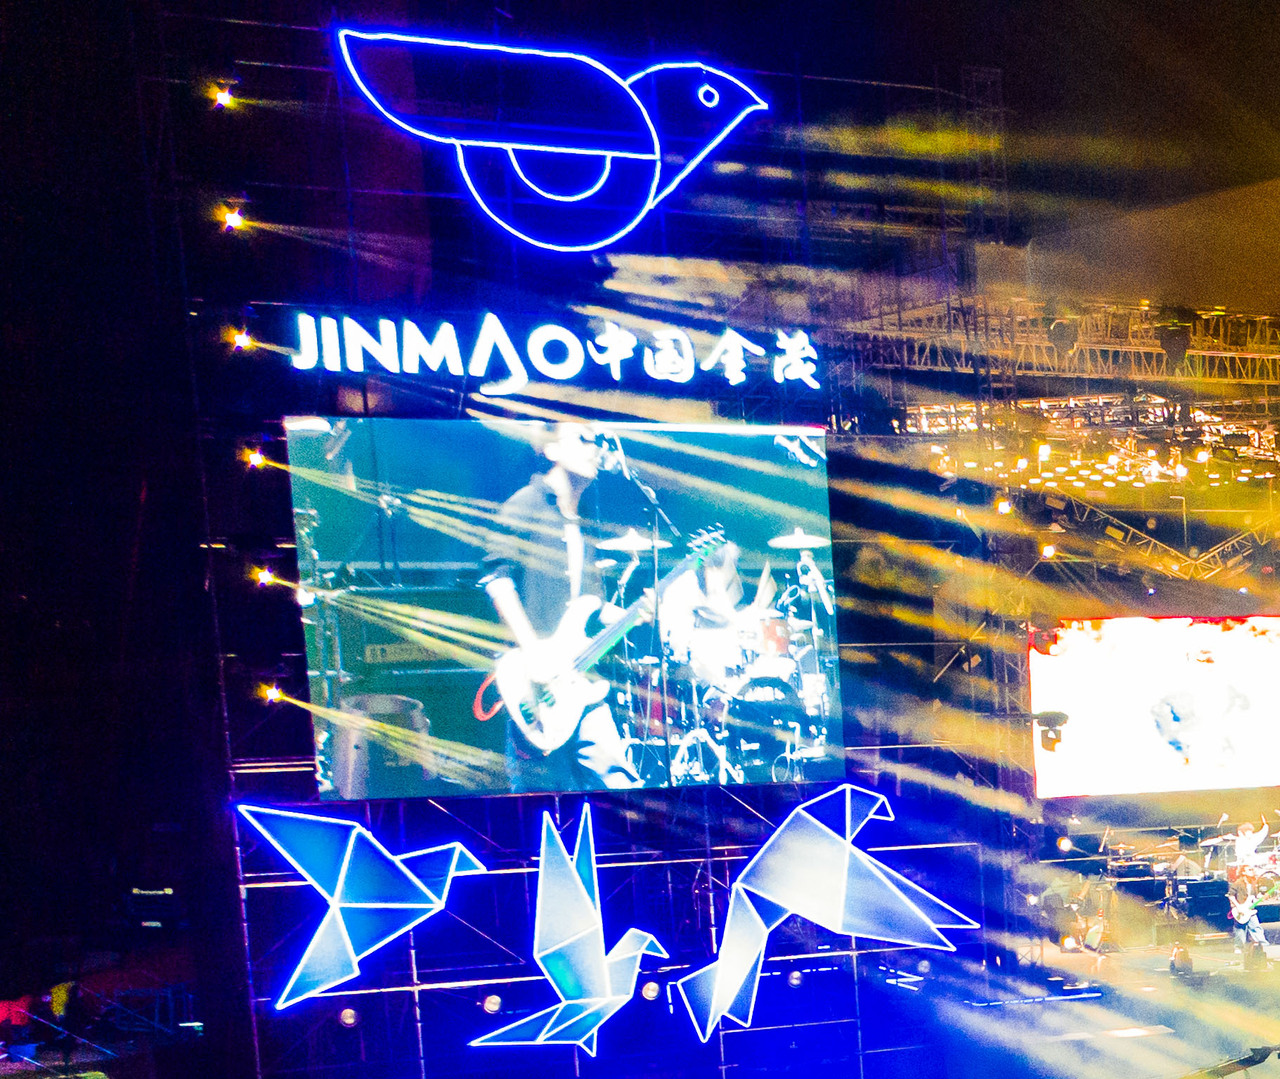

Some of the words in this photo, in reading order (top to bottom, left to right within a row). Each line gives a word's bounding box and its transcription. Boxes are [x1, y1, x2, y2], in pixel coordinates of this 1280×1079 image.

[291, 313, 585, 395] JINMAO
[586, 321, 821, 389] 中国金茂
